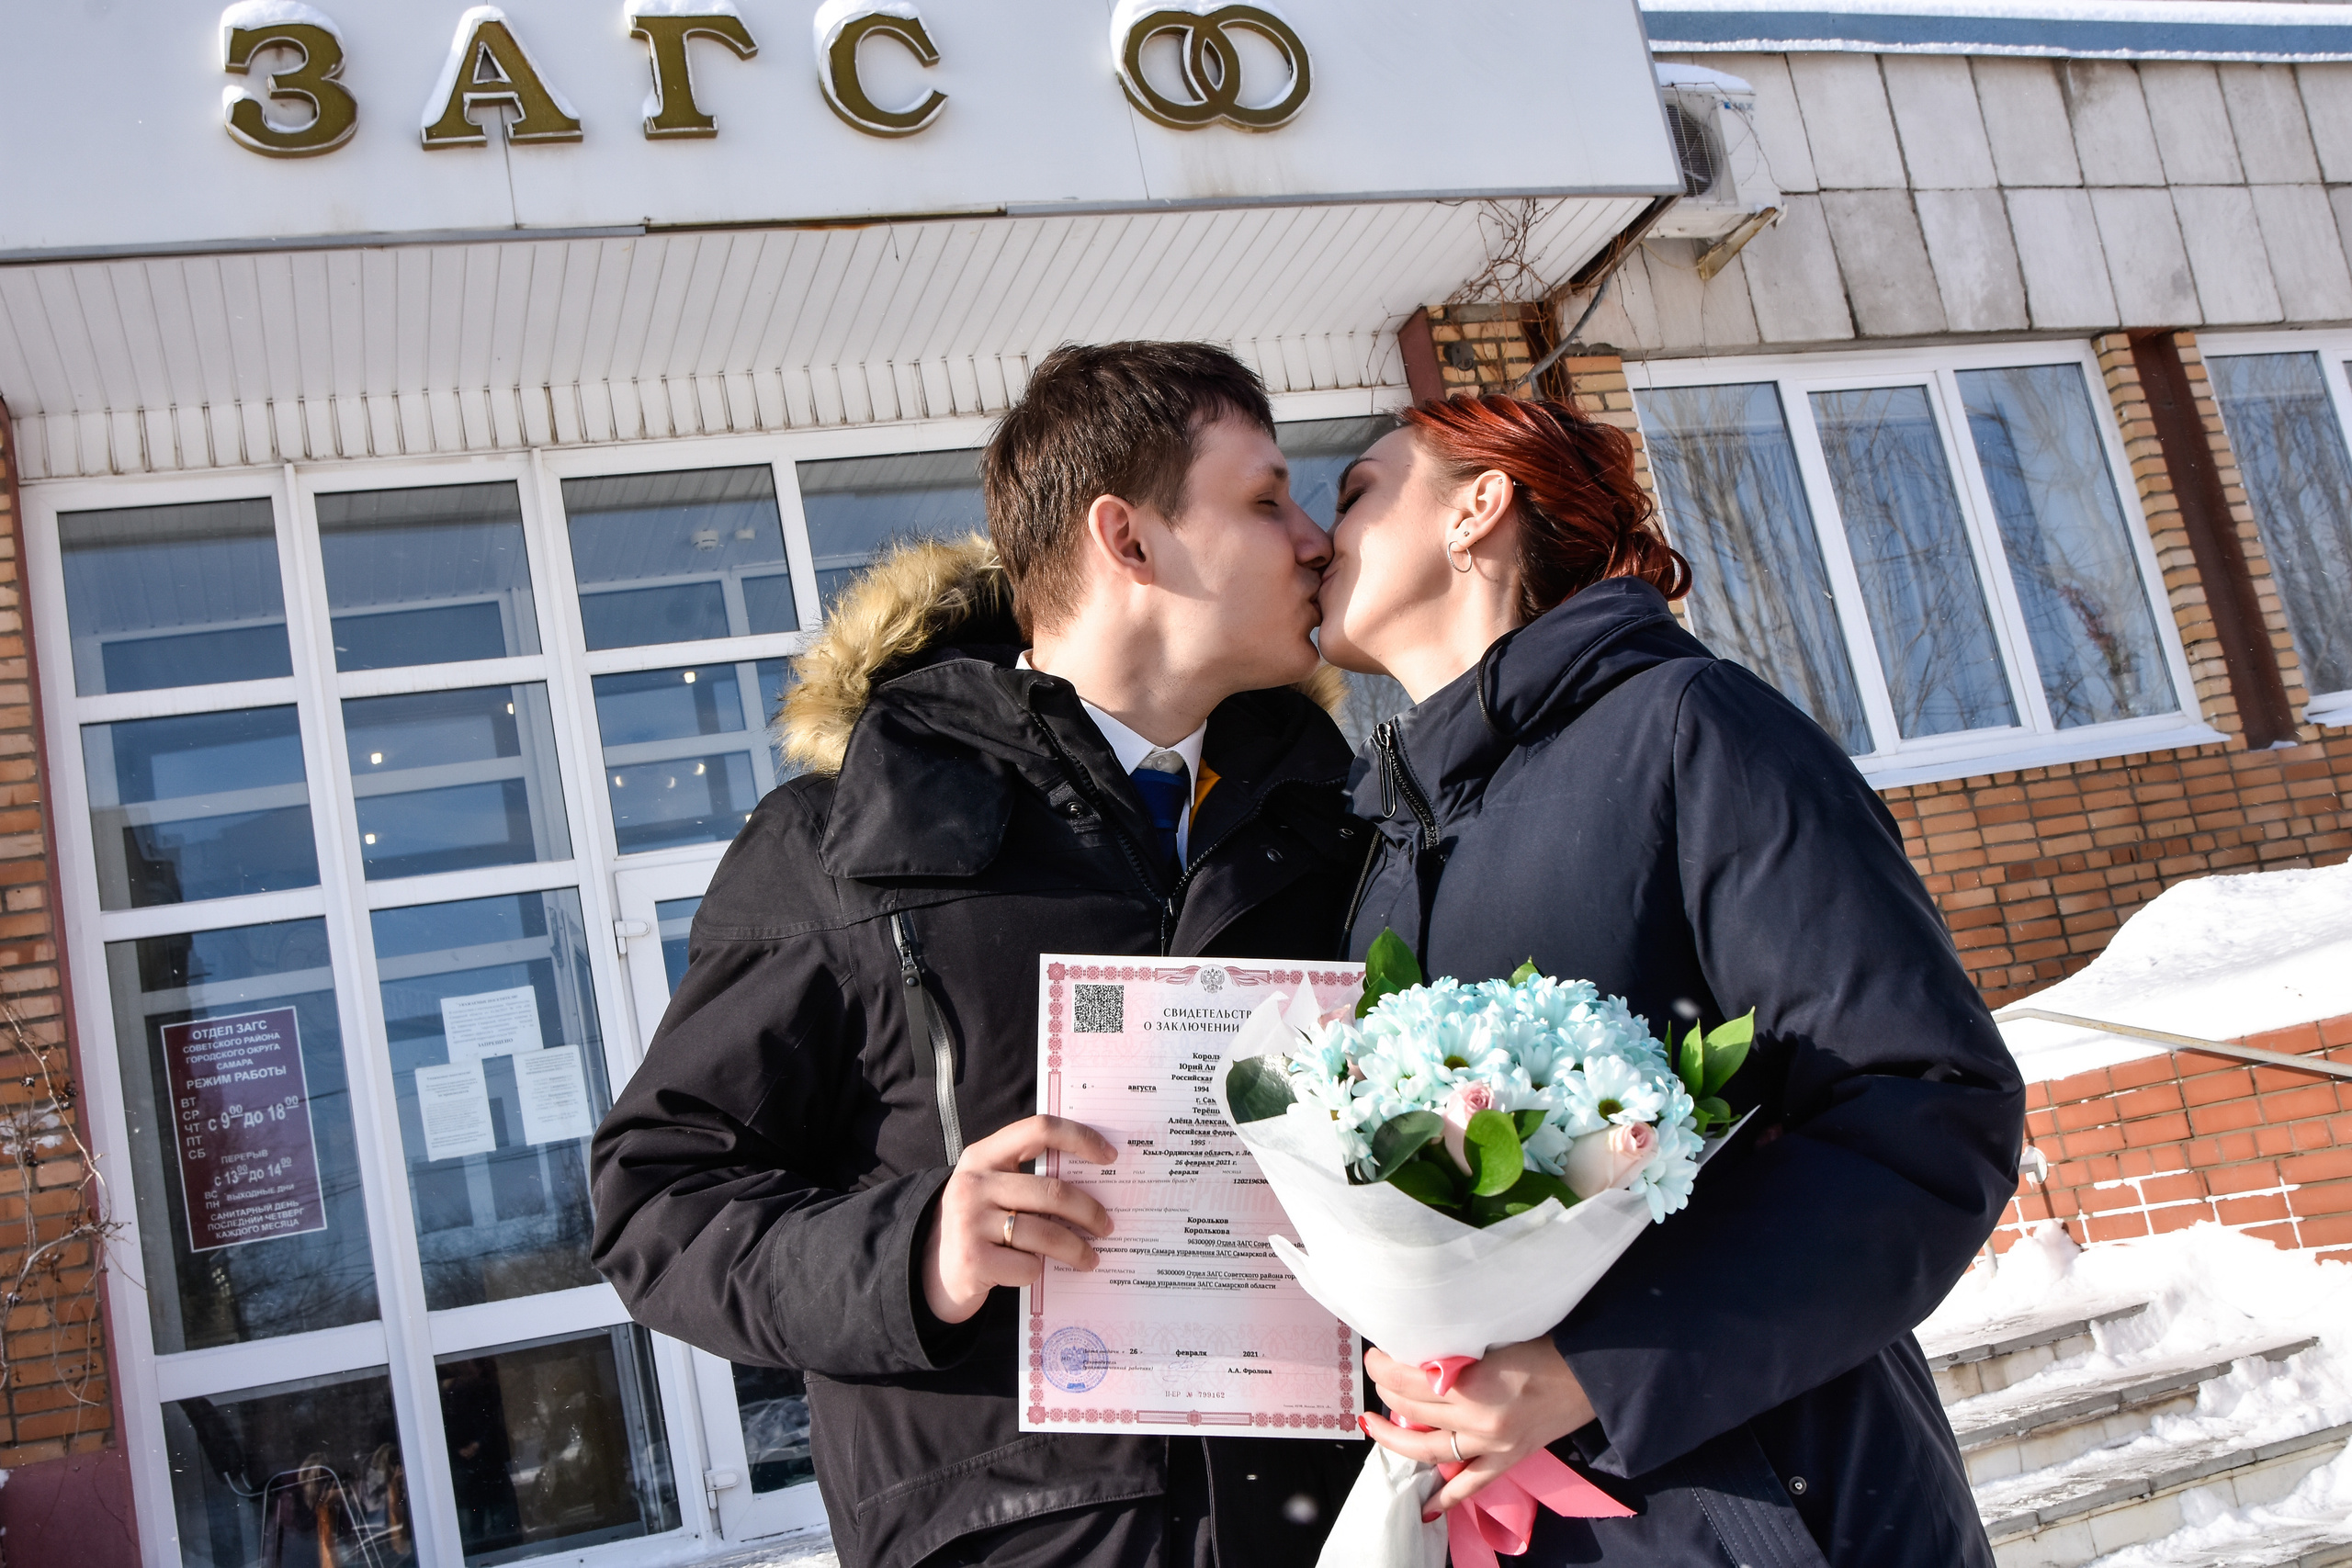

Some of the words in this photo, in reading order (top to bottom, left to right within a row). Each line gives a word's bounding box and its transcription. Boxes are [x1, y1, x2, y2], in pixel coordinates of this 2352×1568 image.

[224, 11, 949, 158] ЗАГС
[1163, 1008, 1252, 1019] СВИДЕТЕЛЬСТ
[193, 1025, 232, 1040] ОТДЕЛ
[236, 1021, 267, 1033] ЗАГС
[1144, 1021, 1152, 1031] О
[1156, 1021, 1239, 1032] ЗАКЛЮЧЕНИИ
[184, 1037, 242, 1054] СОВЕТСКОГО
[244, 1032, 280, 1044] РАЙОНА
[187, 1048, 244, 1064] ГОРОДСКОГО
[247, 1043, 280, 1055] ОКРУГА
[216, 1058, 254, 1070] САМАРА
[1179, 1063, 1203, 1072] Юрий
[187, 1075, 232, 1089] РЕЖИМ
[234, 1066, 287, 1082] РАБОТЫ
[1128, 1085, 1157, 1093] августа
[181, 1097, 197, 1108] ВТ
[183, 1110, 199, 1121] СР
[243, 1111, 264, 1128] до
[185, 1122, 200, 1133] ЧТ
[187, 1135, 202, 1146] ПТ
[188, 1148, 206, 1159] СБ
[220, 1149, 268, 1164] ПЕРЕРЫВ
[1142, 1149, 1203, 1157] Кзыл-Ординская
[248, 1169, 265, 1183] до
[204, 1190, 218, 1200] ВС
[227, 1187, 275, 1201] ВЫХОДНЫЕ
[277, 1184, 295, 1193] ДНИ
[206, 1201, 220, 1209] ПН
[210, 1204, 273, 1221] САНИТАРНЫЙ
[275, 1201, 300, 1211] ДЕНЬ
[208, 1215, 264, 1231] ПОСЛЕДНИЙ
[265, 1208, 305, 1221] ЧЕТВЕРГ
[216, 1225, 260, 1239] КАЖДОГО
[262, 1218, 300, 1231] МЕСЯЦА
[1129, 1247, 1150, 1256] округа
[1152, 1247, 1175, 1256] Самара
[1177, 1249, 1215, 1258] управления
[1233, 1250, 1267, 1258] Самарской
[1110, 1279, 1131, 1287] округа
[1133, 1279, 1156, 1287] Самара
[1158, 1280, 1195, 1289] управления
[1215, 1281, 1249, 1290] Самарской
[1243, 1367, 1272, 1375] Фролова
[1198, 1391, 1226, 1399] 799162
